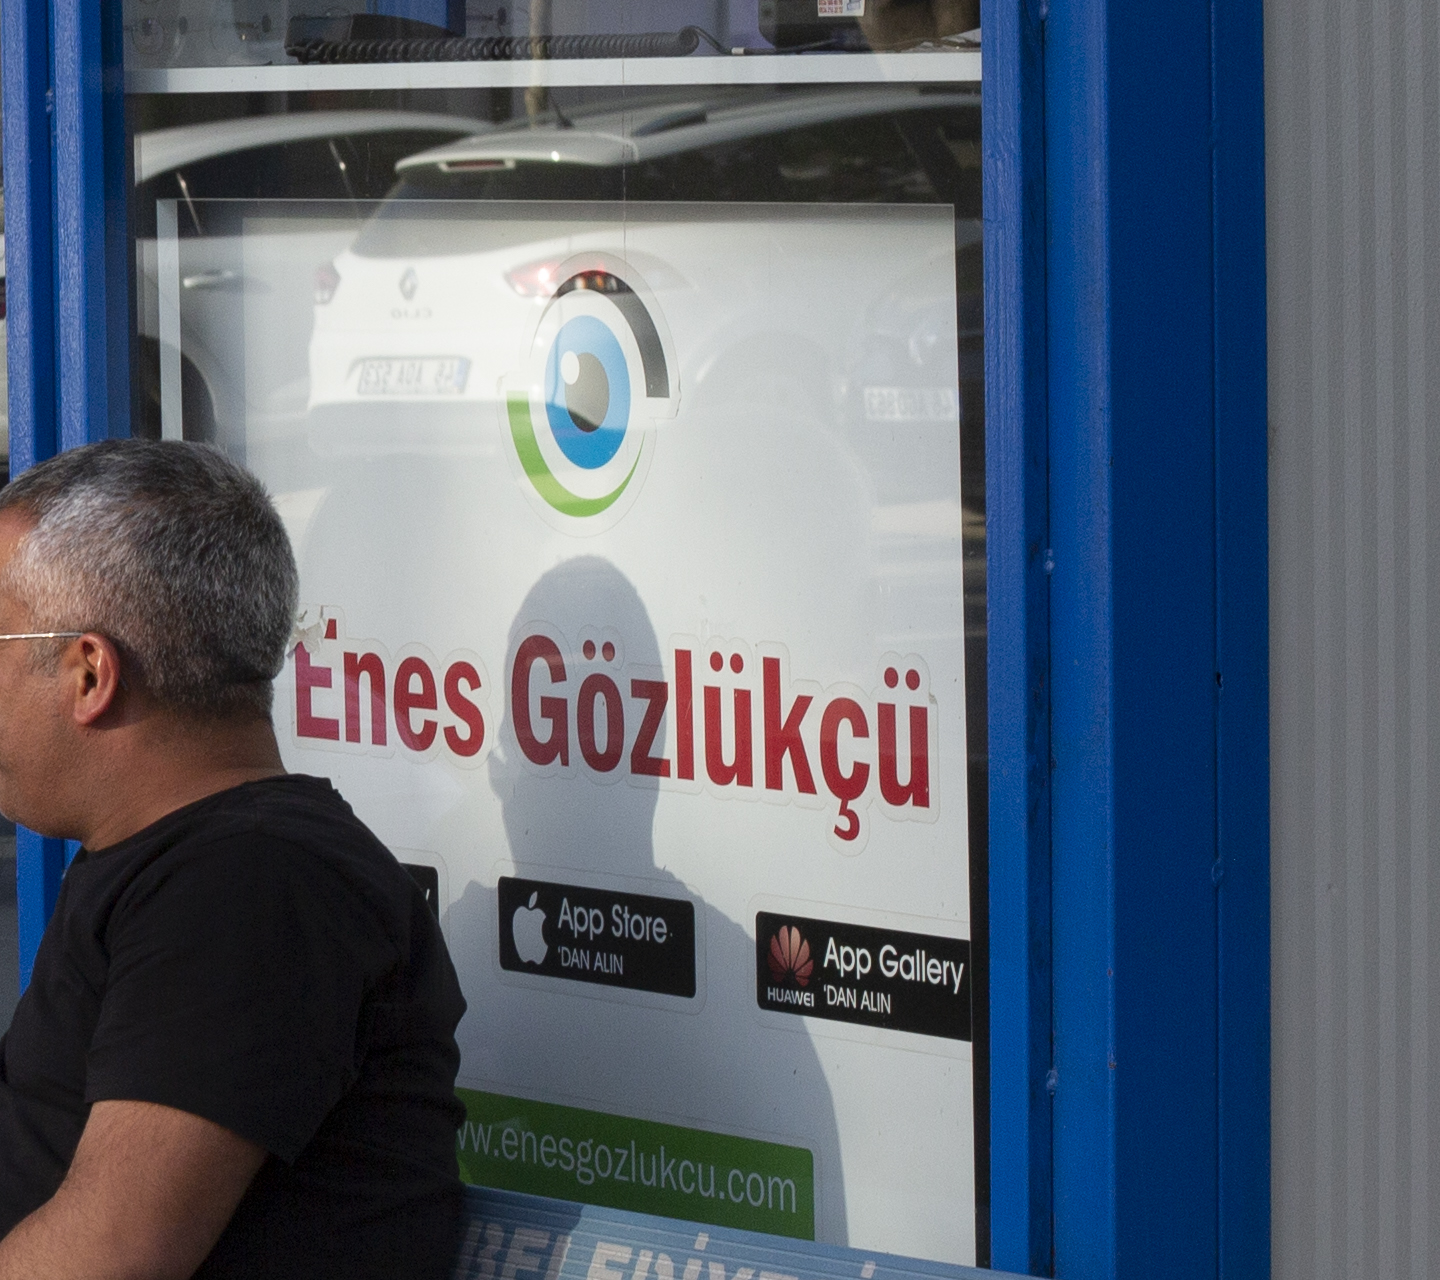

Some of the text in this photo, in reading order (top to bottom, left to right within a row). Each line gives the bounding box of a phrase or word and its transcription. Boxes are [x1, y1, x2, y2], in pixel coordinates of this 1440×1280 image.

[295, 618, 929, 841] Enes Gözlükçü
[558, 898, 667, 944] App Store
[594, 952, 623, 975] ALIN
[823, 937, 964, 994] App Gallery
[767, 986, 815, 1008] HUAWEI
[861, 990, 891, 1014] ALIN
